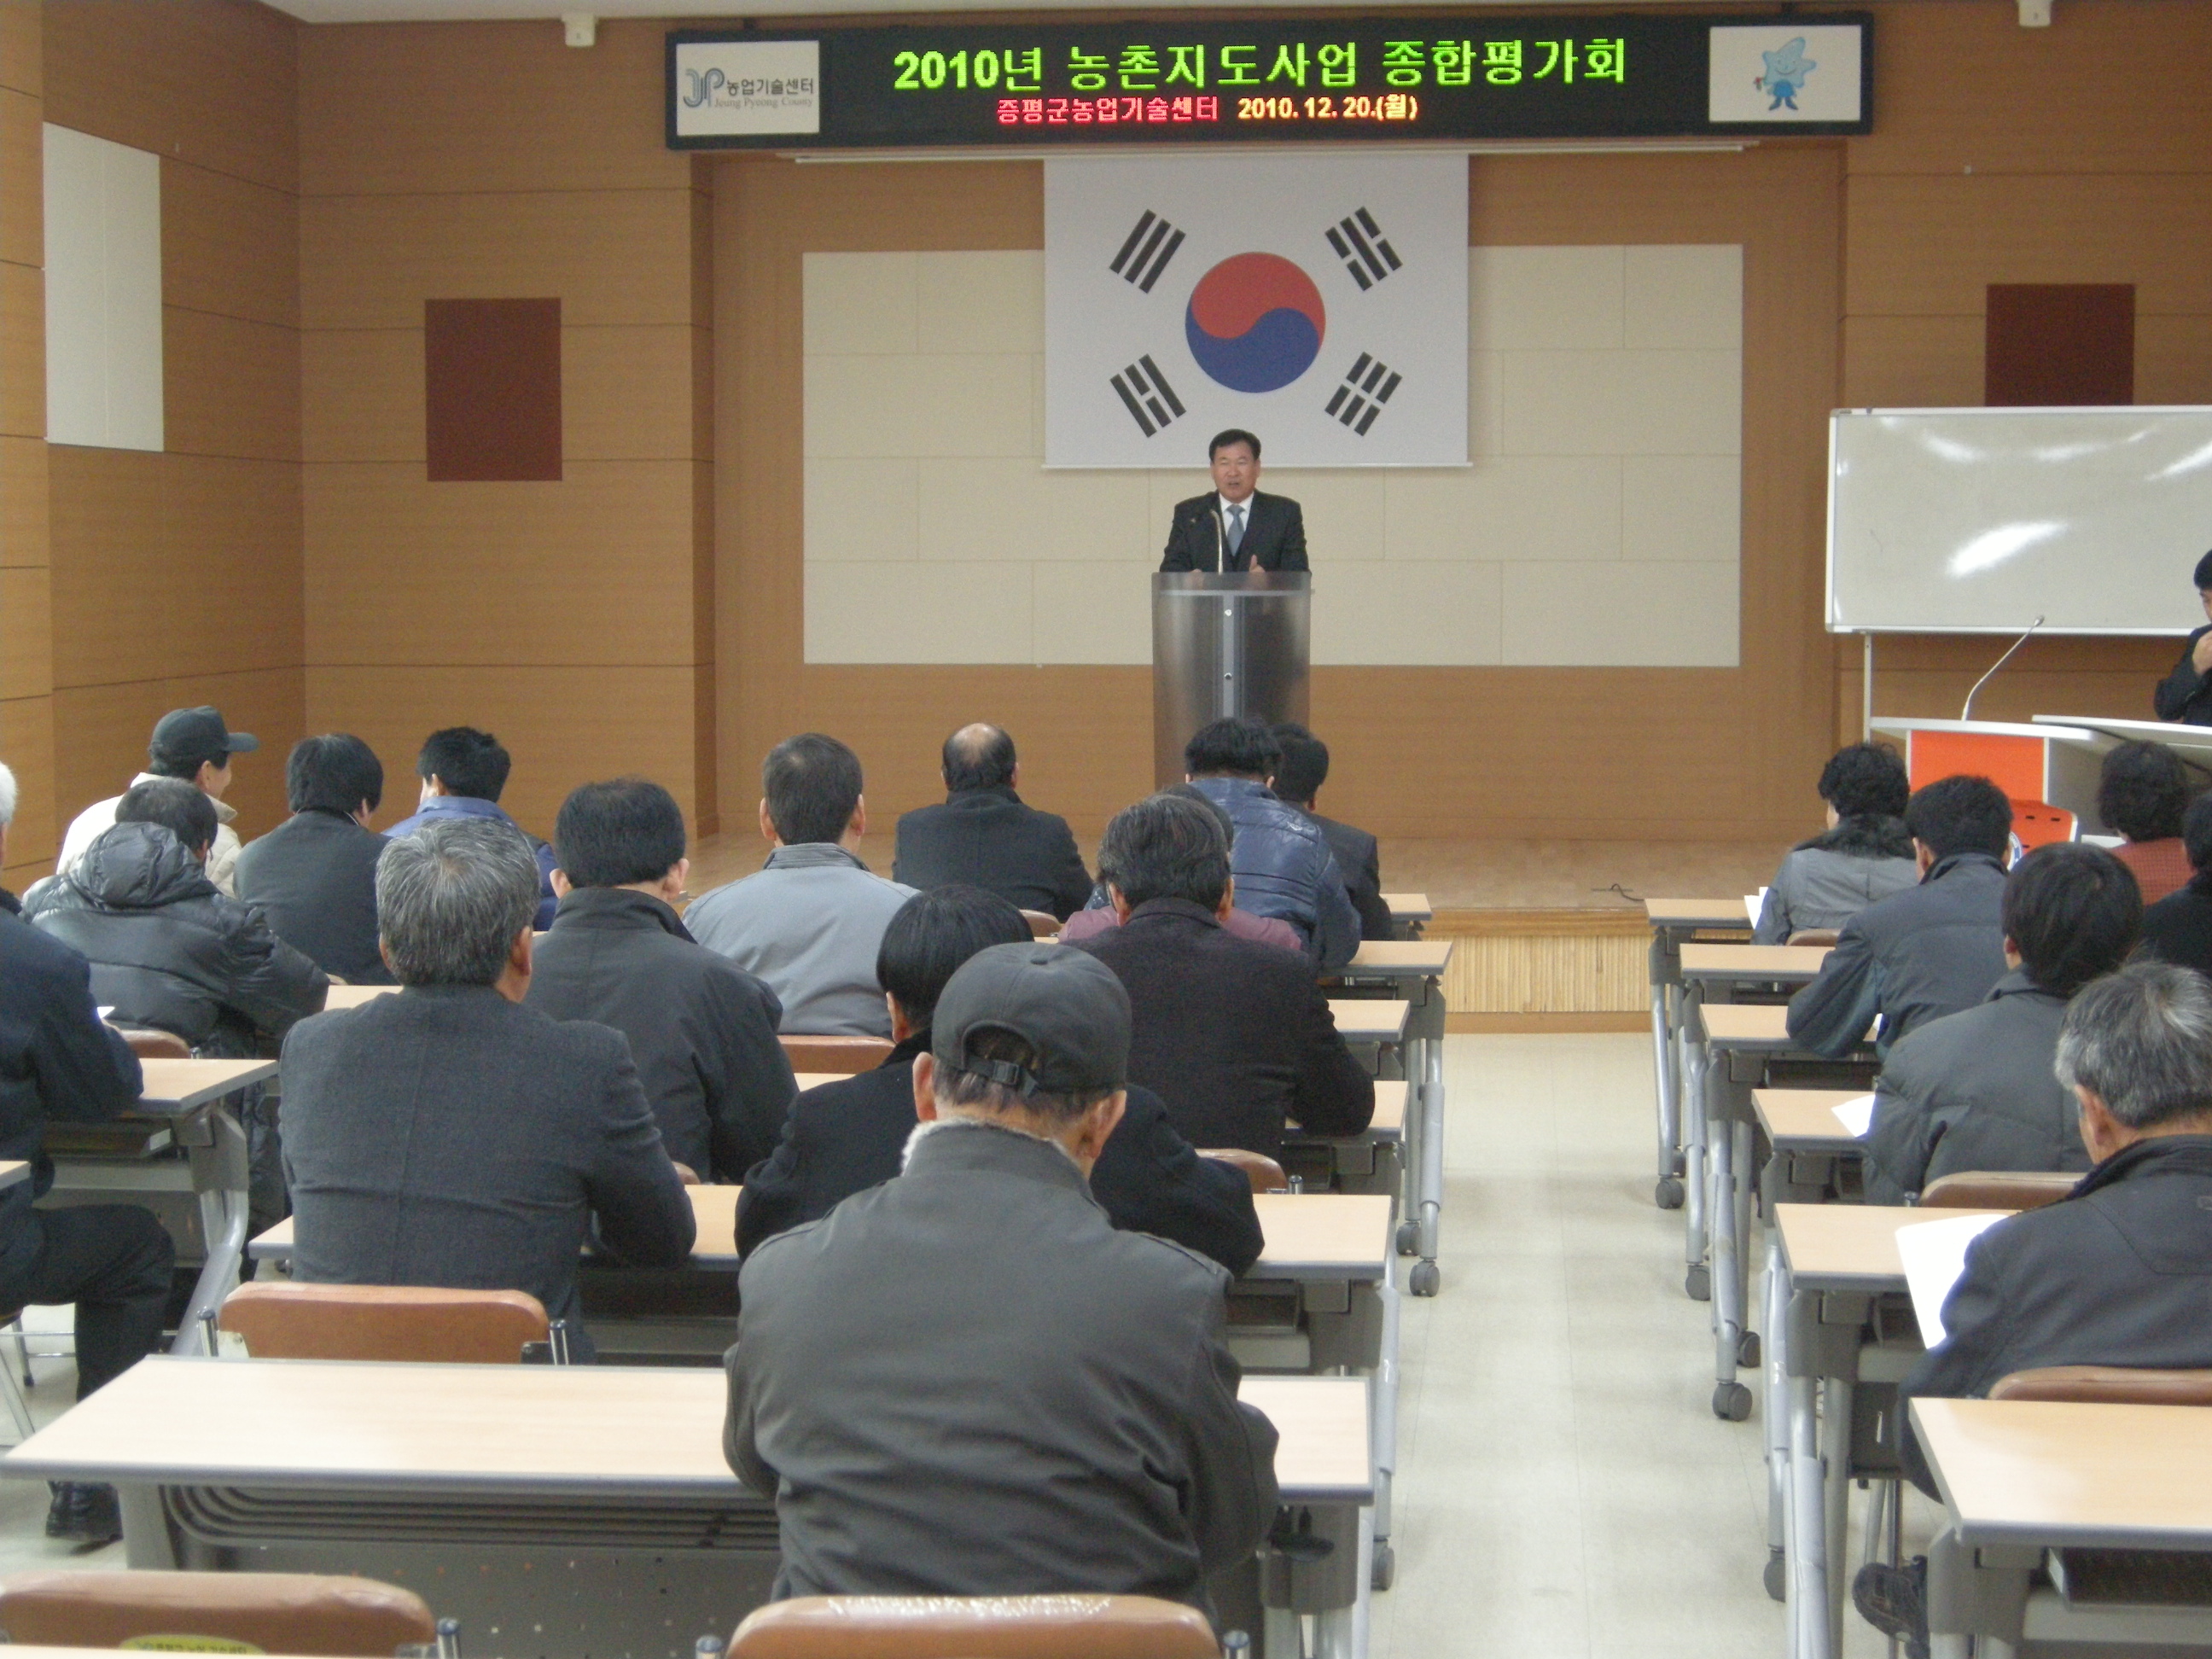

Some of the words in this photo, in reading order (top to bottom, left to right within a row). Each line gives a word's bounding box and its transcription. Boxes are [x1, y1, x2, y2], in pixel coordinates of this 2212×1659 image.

[894, 46, 1042, 91] 2010년
[1068, 43, 1356, 90] 농촌지도사업
[1382, 38, 1625, 86] 종합평가회
[726, 79, 814, 96] 농업기술센터
[714, 98, 742, 108] Jeung
[997, 96, 1219, 125] 증평군농업기술센터
